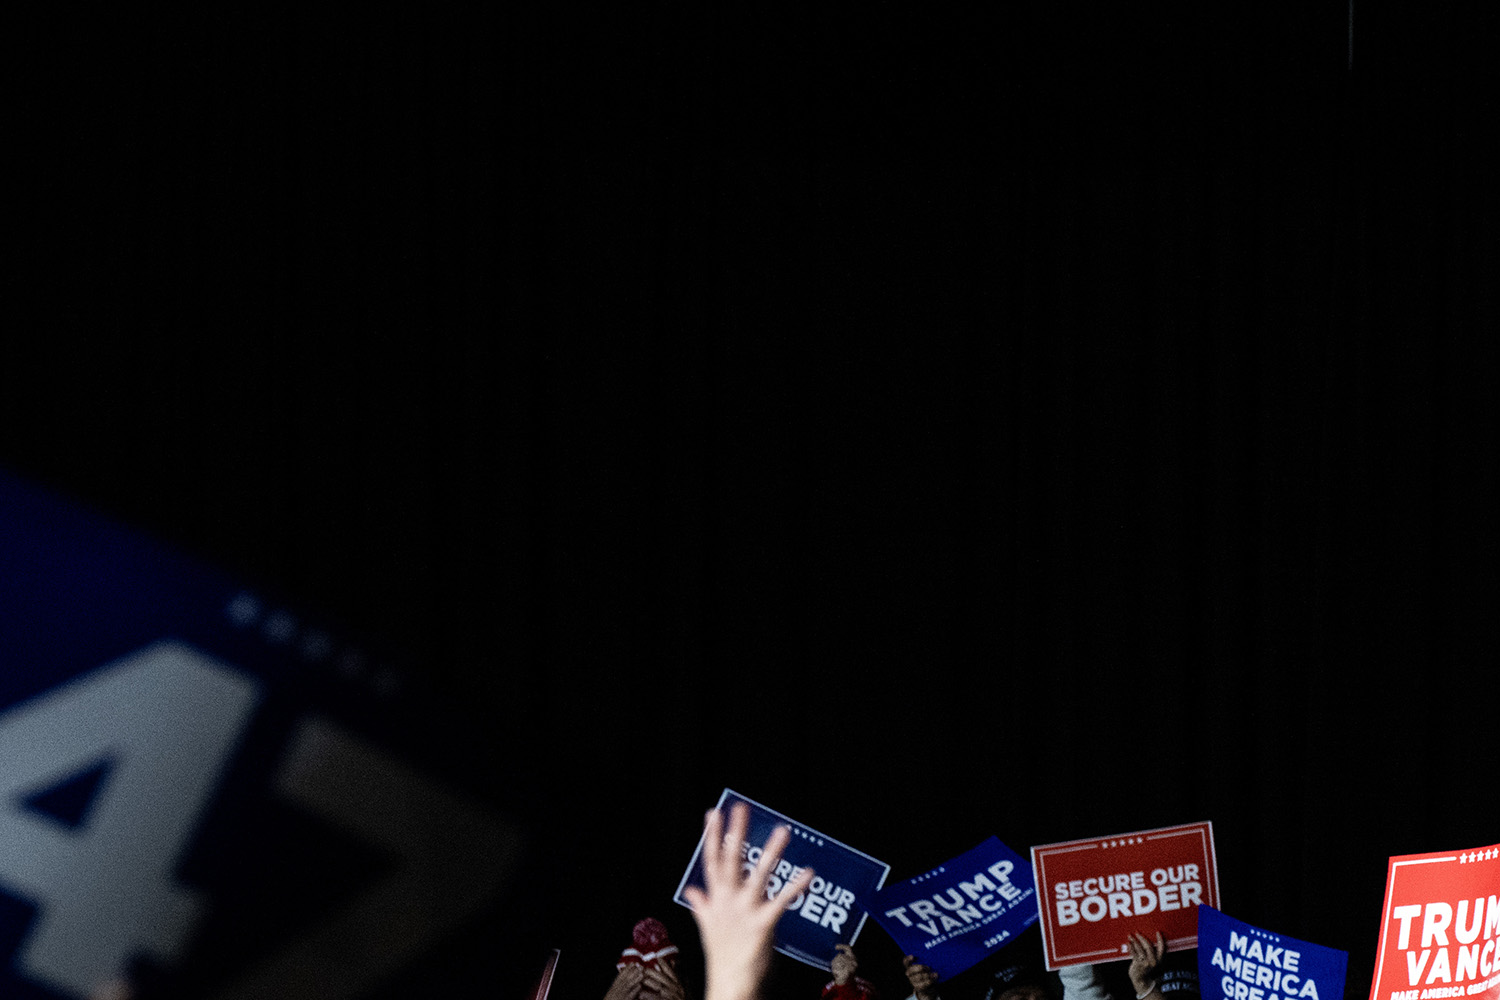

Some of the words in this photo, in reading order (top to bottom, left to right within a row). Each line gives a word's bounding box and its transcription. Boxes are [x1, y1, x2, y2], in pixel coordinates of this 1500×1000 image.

[809, 876, 856, 910] OUR
[885, 860, 1014, 927] TRUMP
[1054, 872, 1145, 900] SECURE
[1150, 863, 1199, 887] OUR
[916, 882, 1021, 936] VANCE
[1056, 881, 1203, 926] BORDER
[1229, 931, 1300, 972] MAKE
[1211, 948, 1319, 1000] AMERICA
[1420, 986, 1465, 1000] AMERICA
